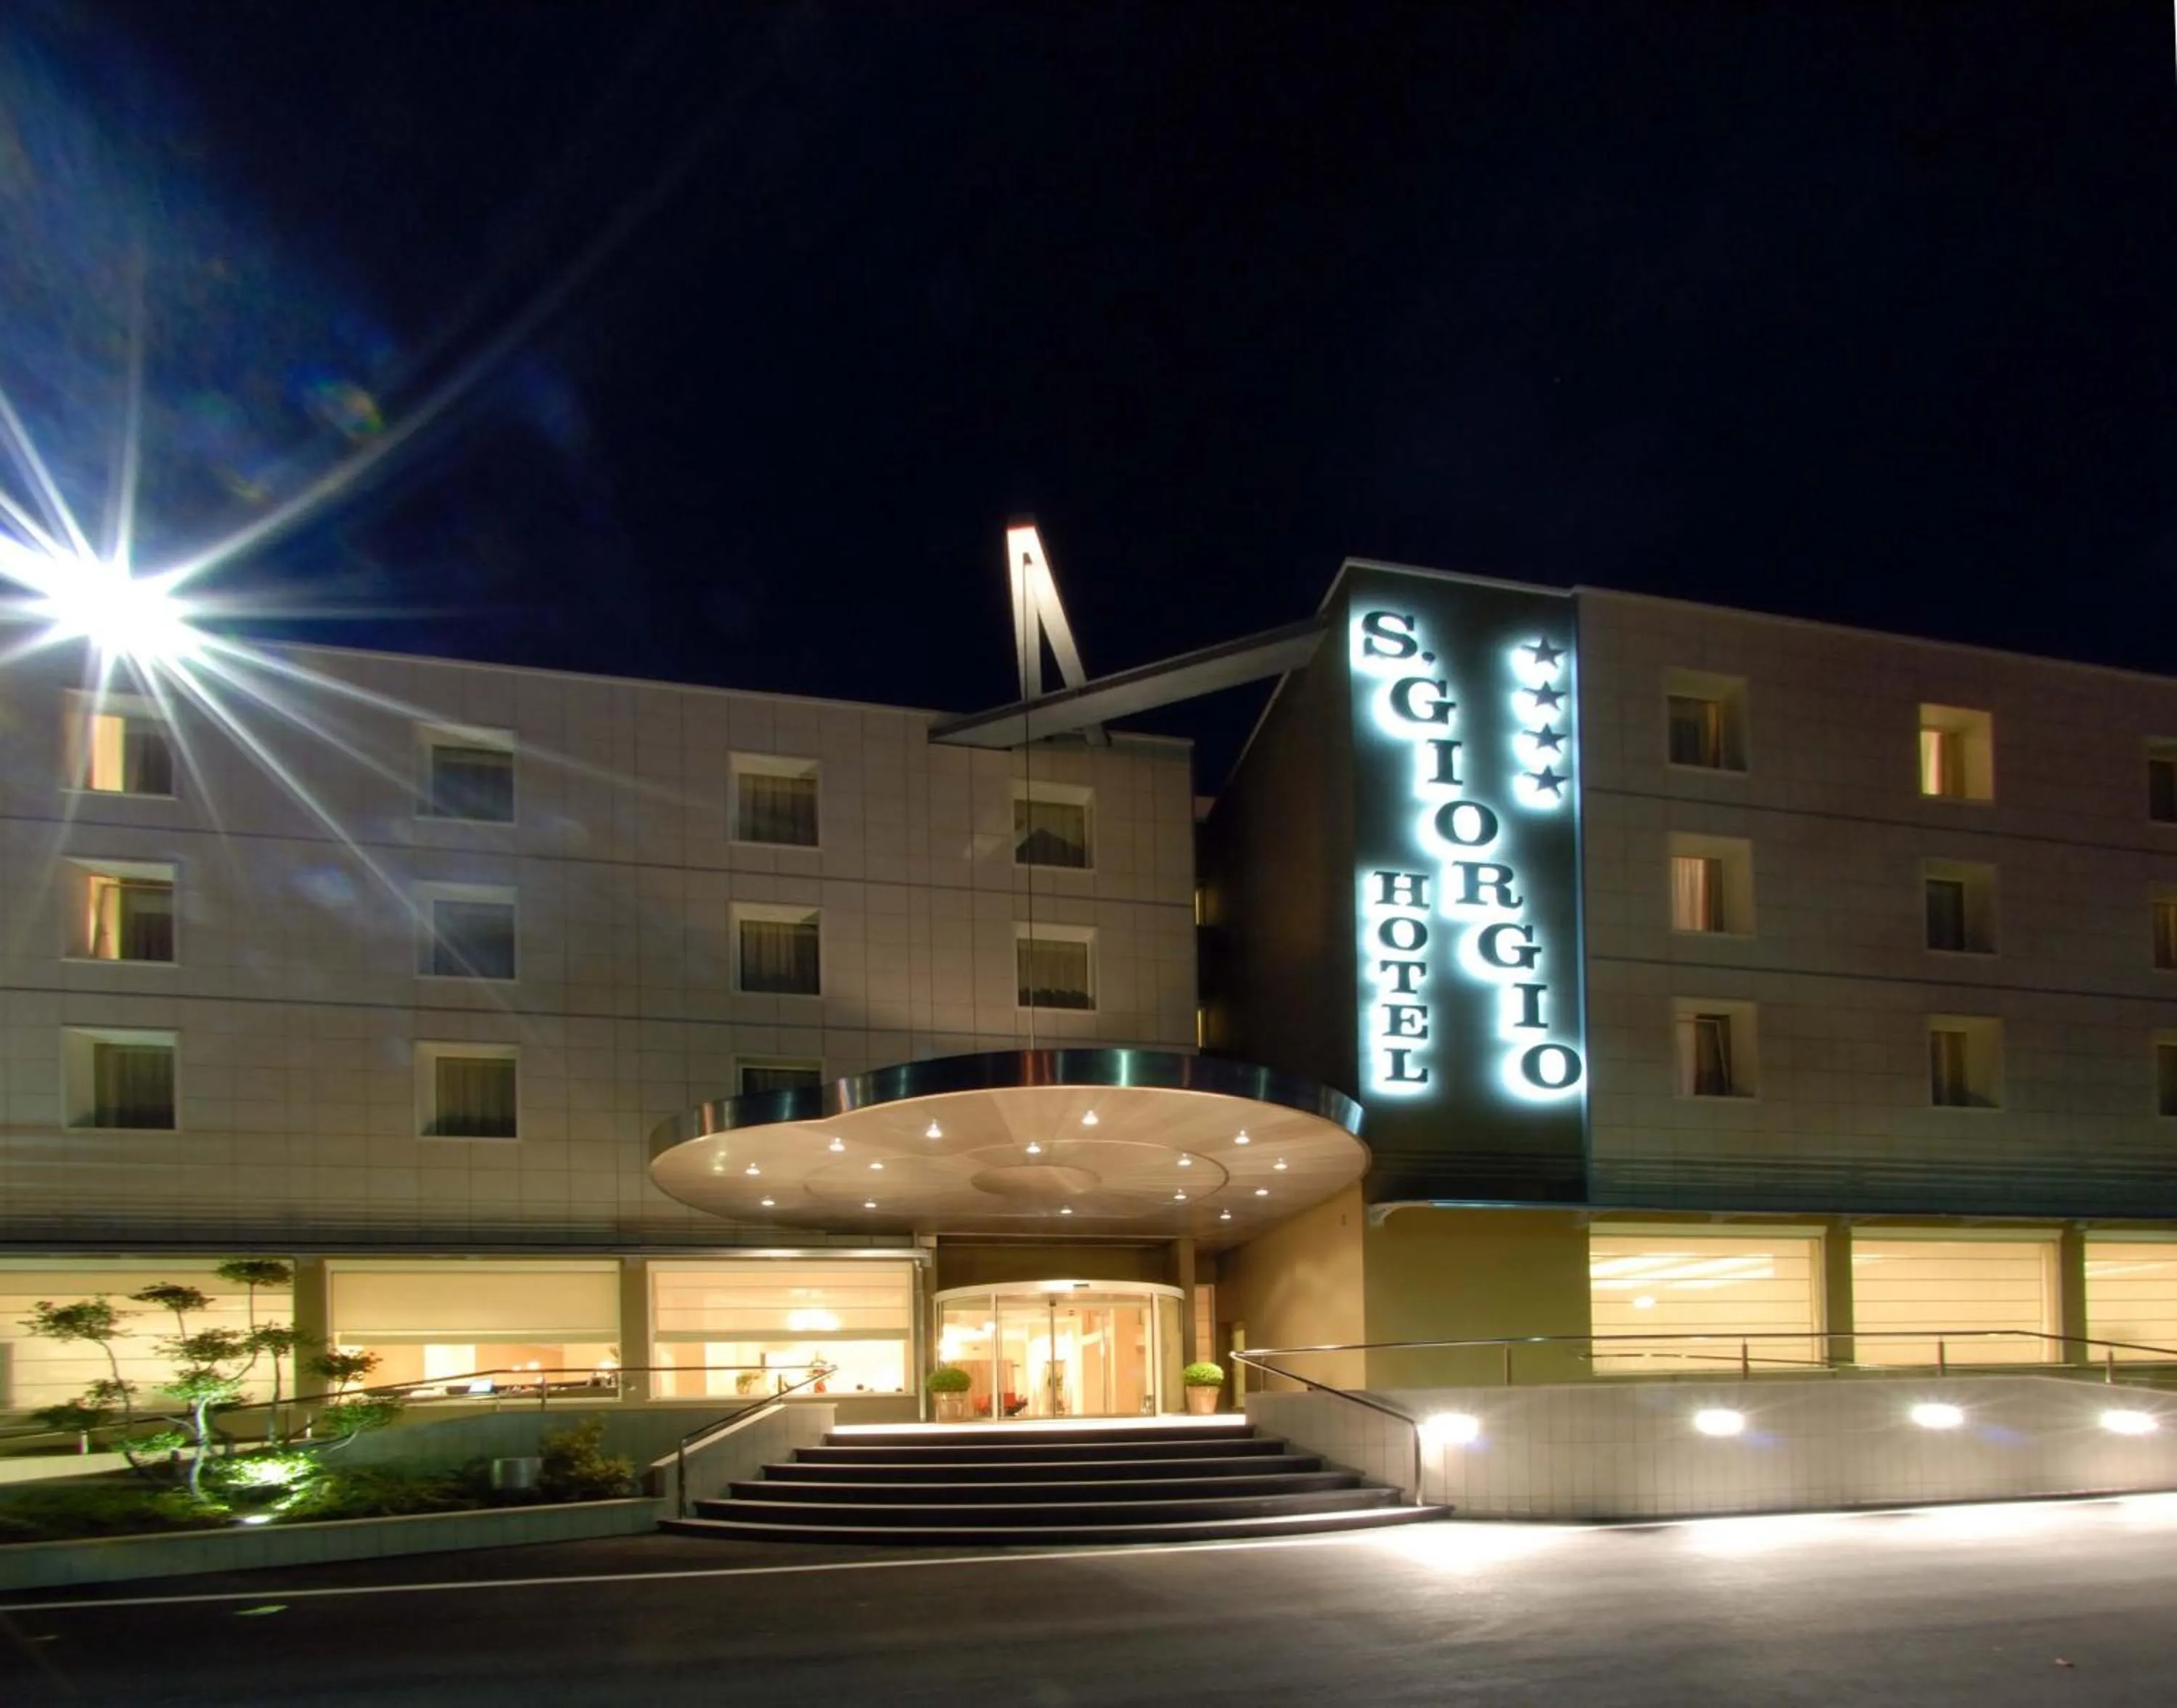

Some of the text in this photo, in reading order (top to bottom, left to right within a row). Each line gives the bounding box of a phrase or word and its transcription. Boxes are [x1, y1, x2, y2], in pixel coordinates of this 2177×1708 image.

[1361, 610, 1582, 1090] S. GIORGIO
[1374, 871, 1430, 1083] HOTEL
